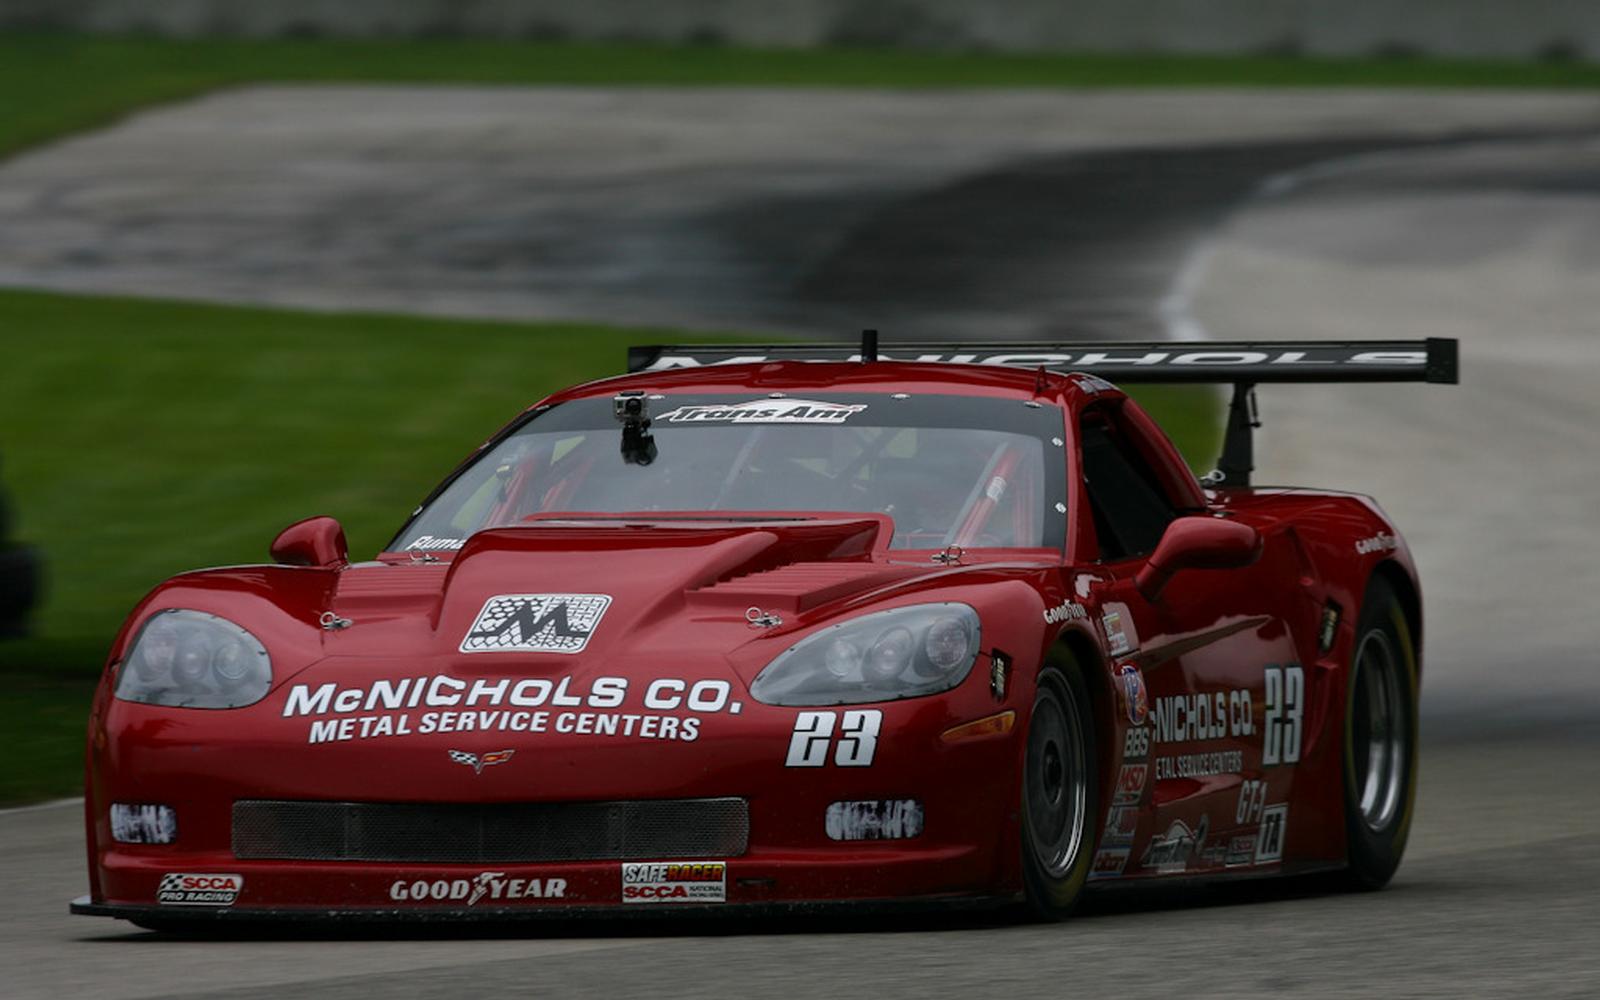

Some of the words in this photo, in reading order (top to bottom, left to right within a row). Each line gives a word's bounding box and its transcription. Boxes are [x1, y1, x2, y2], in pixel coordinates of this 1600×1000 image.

[671, 405, 777, 421] Trans
[778, 405, 852, 420] Am
[643, 678, 743, 714] CO.
[1228, 688, 1257, 738] CO.
[308, 713, 411, 744] METAL
[418, 710, 550, 734] SERVICE
[555, 711, 701, 742] CENTERS
[1262, 666, 1304, 766] 23
[784, 708, 883, 768] 23
[1123, 727, 1149, 758] BBS
[1236, 779, 1268, 825] GT-1
[159, 891, 185, 902] PRO
[185, 891, 234, 902] RACING
[182, 877, 237, 890] SCCA
[623, 885, 689, 899] SCCA
